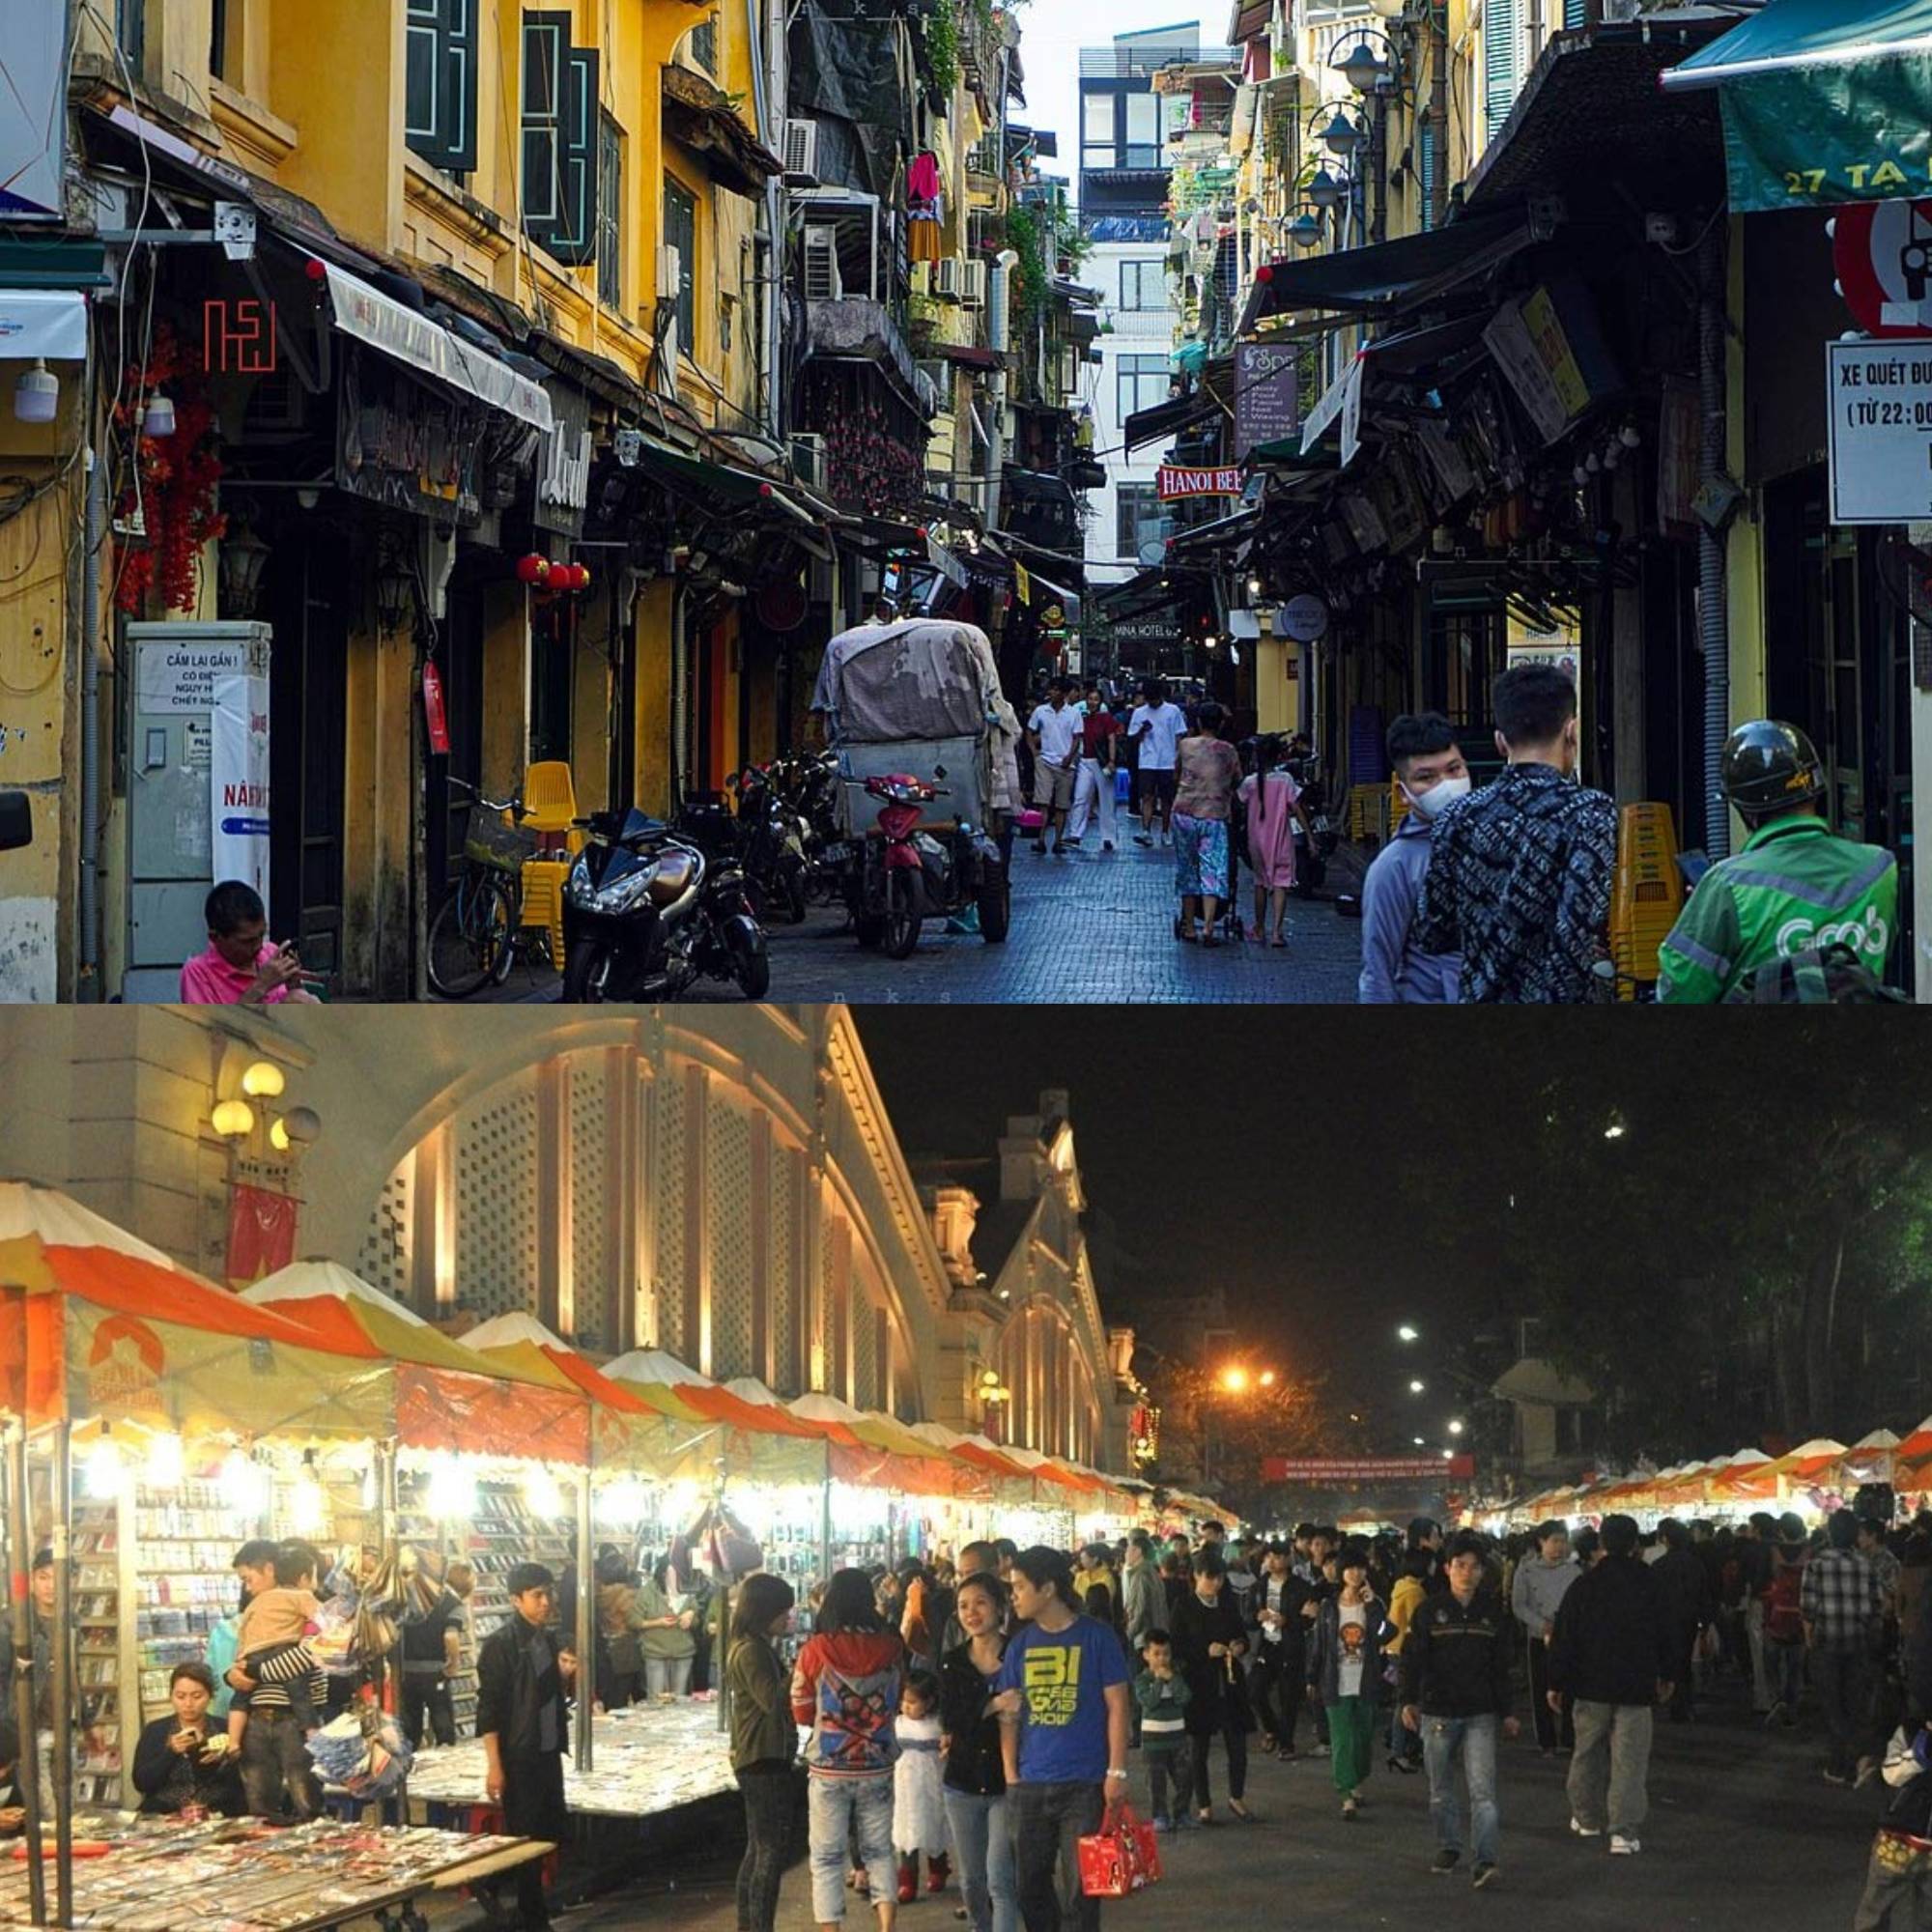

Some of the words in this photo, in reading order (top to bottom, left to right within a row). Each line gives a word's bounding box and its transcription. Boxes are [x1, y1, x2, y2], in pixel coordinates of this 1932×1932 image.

[1785, 169, 1826, 193] 27
[1845, 160, 1908, 190] TẠ
[1841, 363, 1861, 386] XE
[1866, 357, 1906, 385] QUÉT
[1162, 469, 1212, 495] HANOI
[1217, 468, 1247, 492] BEE
